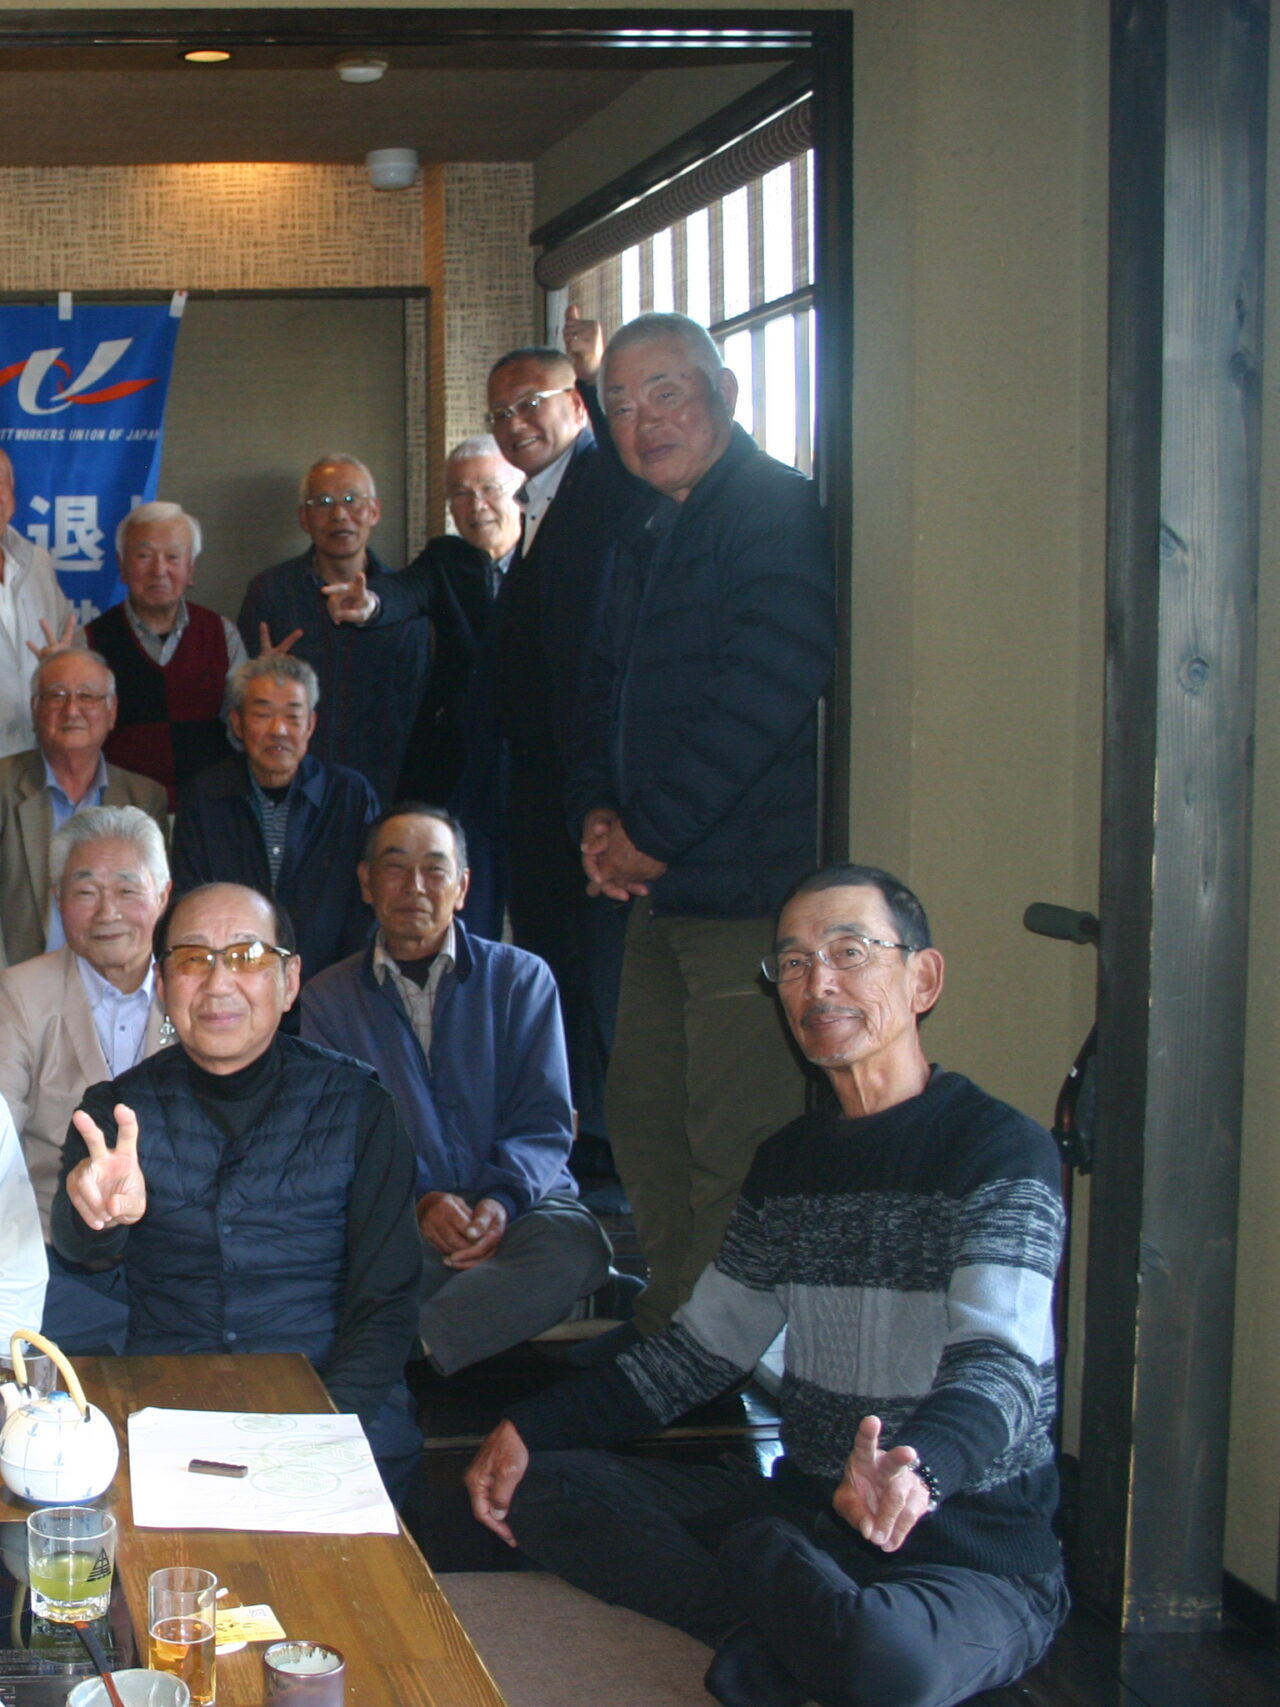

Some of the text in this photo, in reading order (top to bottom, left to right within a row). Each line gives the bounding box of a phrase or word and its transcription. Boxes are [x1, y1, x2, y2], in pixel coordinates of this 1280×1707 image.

[14, 428, 66, 441] WORKERS
[68, 428, 106, 441] UNION
[108, 428, 124, 441] OF
